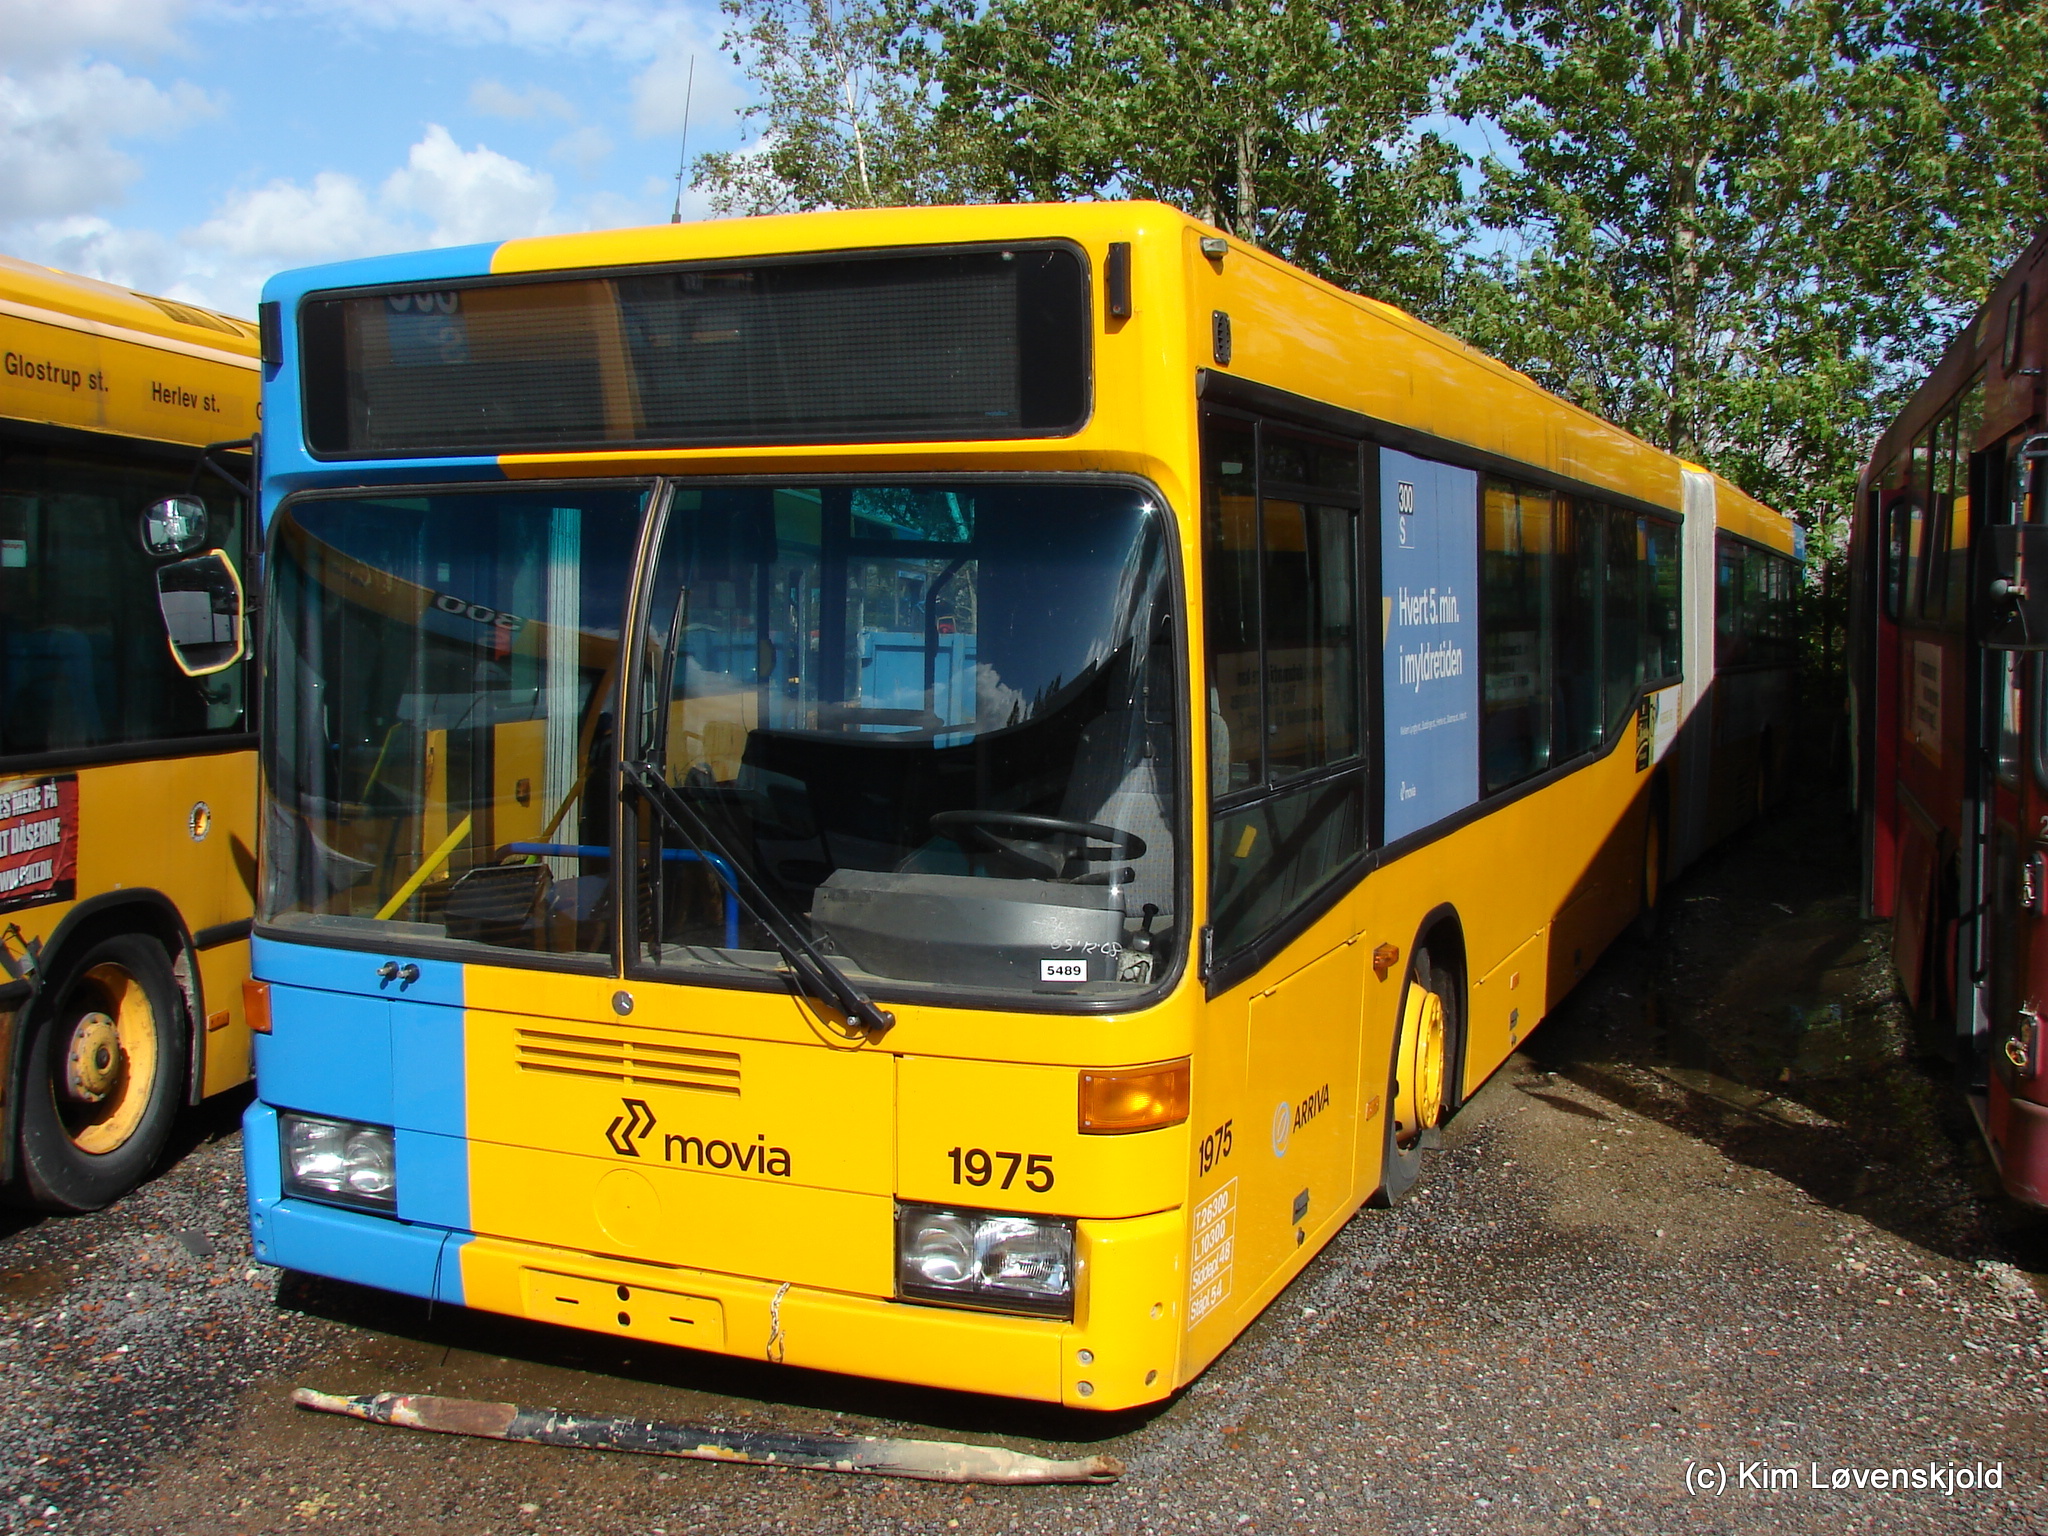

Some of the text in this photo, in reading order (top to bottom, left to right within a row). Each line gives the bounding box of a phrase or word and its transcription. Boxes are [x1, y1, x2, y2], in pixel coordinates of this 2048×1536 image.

[4, 352, 109, 392] Glostrup st.
[152, 381, 220, 413] Herlev st.
[1399, 483, 1413, 513] 300
[1399, 515, 1406, 545] S
[1399, 586, 1460, 626] Hvert 5. min.
[1399, 644, 1403, 685] i
[1404, 640, 1462, 693] myldretiden
[43, 777, 58, 809] PÅ
[10, 818, 61, 855] DÅSERNE
[1047, 965, 1081, 976] 5489
[1292, 1083, 1330, 1134] ARRIVA
[664, 1133, 792, 1178] movia
[1199, 1118, 1232, 1178] 1975
[947, 1146, 1055, 1193] 1975
[1219, 1240, 1231, 1264] 48
[1210, 1278, 1222, 1305] 54
